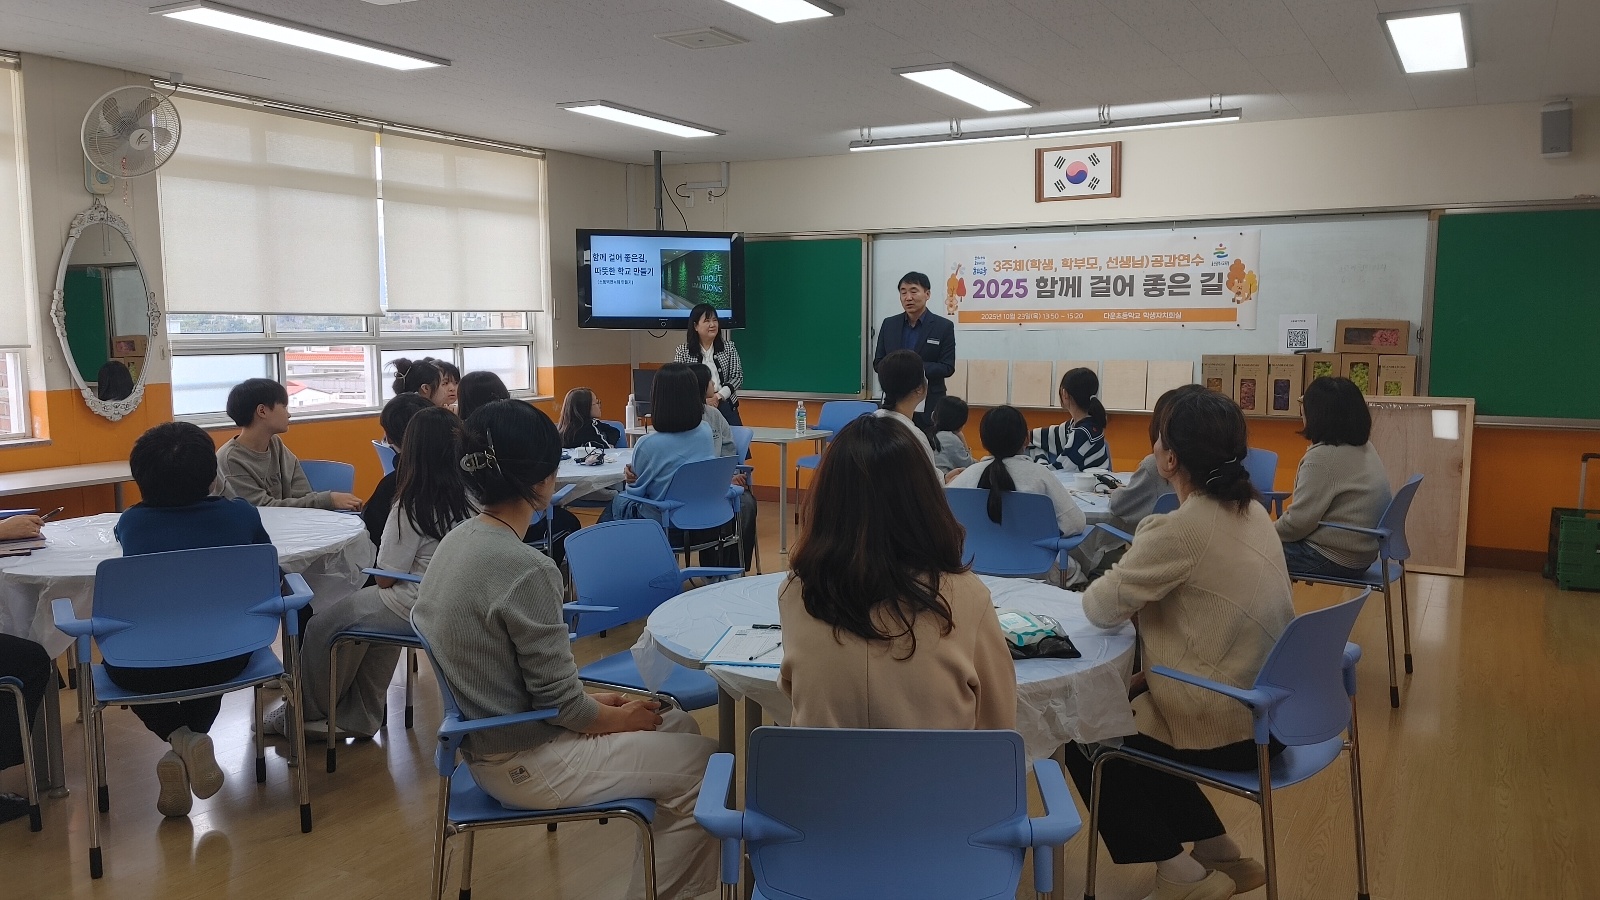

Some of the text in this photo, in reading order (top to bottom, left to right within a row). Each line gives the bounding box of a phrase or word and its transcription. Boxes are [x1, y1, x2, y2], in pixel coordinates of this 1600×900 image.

[592, 252, 648, 264] 함께 걸어 좋은길,
[993, 258, 1058, 273] 3주체(학생,
[1061, 256, 1103, 271] 학부모,
[1106, 253, 1205, 271] 선생님)공감연수
[594, 266, 654, 277] 따뜻한 학교 만들기
[972, 271, 1224, 299] 2025 함께 걸어 좋은 길
[981, 313, 1001, 321] 2025년
[1003, 312, 1016, 320] 10월
[1103, 312, 1141, 320] 다운초등학교
[1142, 311, 1182, 320] 학생자치회실
